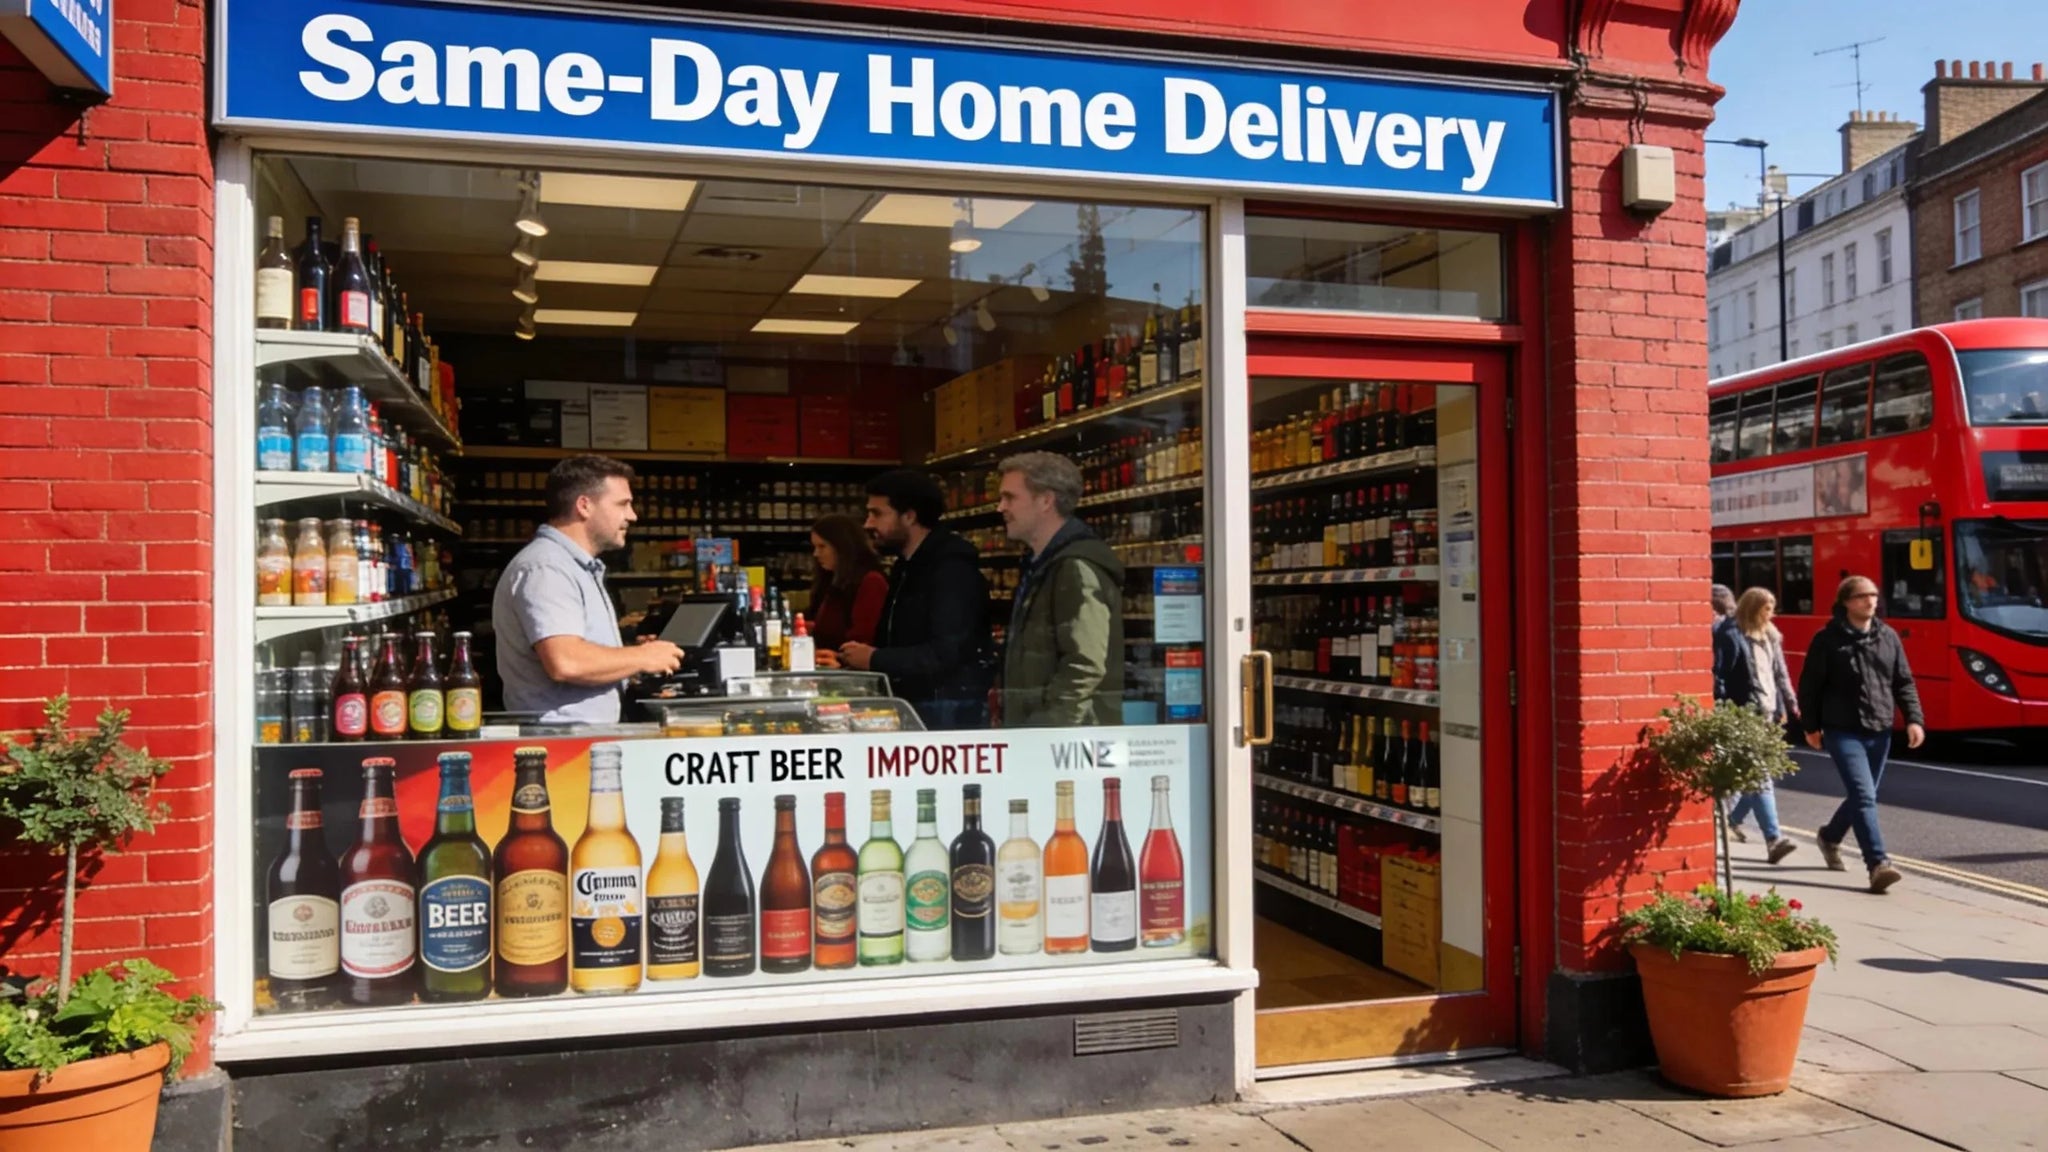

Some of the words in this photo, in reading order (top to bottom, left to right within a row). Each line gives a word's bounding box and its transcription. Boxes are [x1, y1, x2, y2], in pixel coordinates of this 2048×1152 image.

[299, 14, 839, 150] Same-Day
[869, 54, 1136, 151] Home
[1165, 77, 1506, 192] Delivery
[665, 750, 760, 786] CRAFT
[770, 747, 845, 782] BEER
[867, 743, 1009, 779] IMPORTET
[428, 902, 488, 929] BEER
